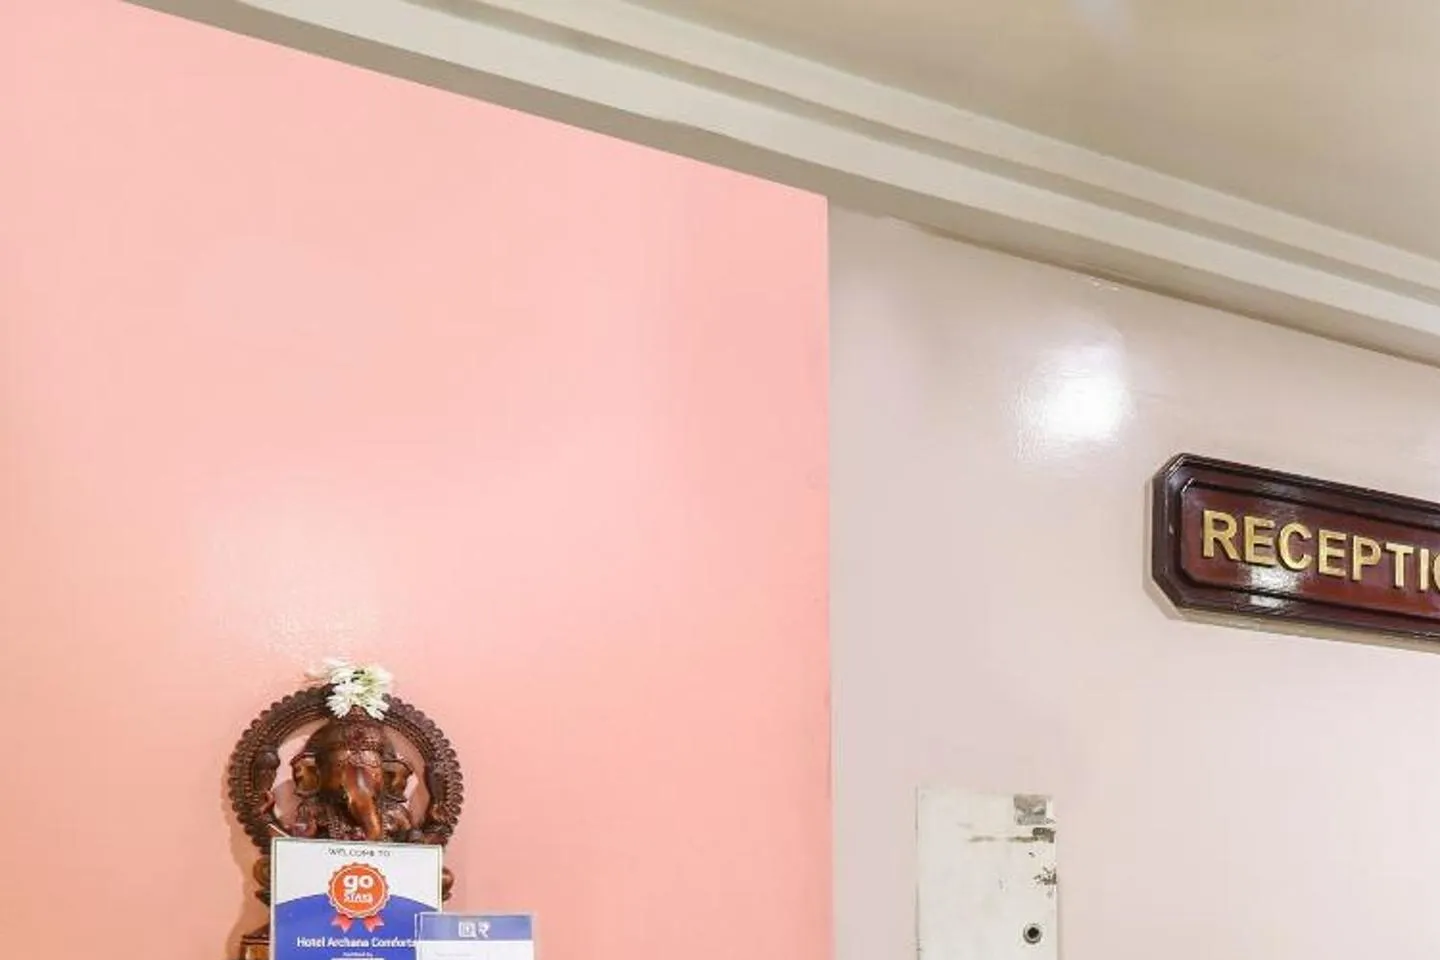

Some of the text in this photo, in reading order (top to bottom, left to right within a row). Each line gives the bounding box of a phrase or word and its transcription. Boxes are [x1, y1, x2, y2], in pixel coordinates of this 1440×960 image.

[343, 874, 374, 893] go
[296, 936, 326, 948] Hotel
[326, 937, 370, 948] Archana
